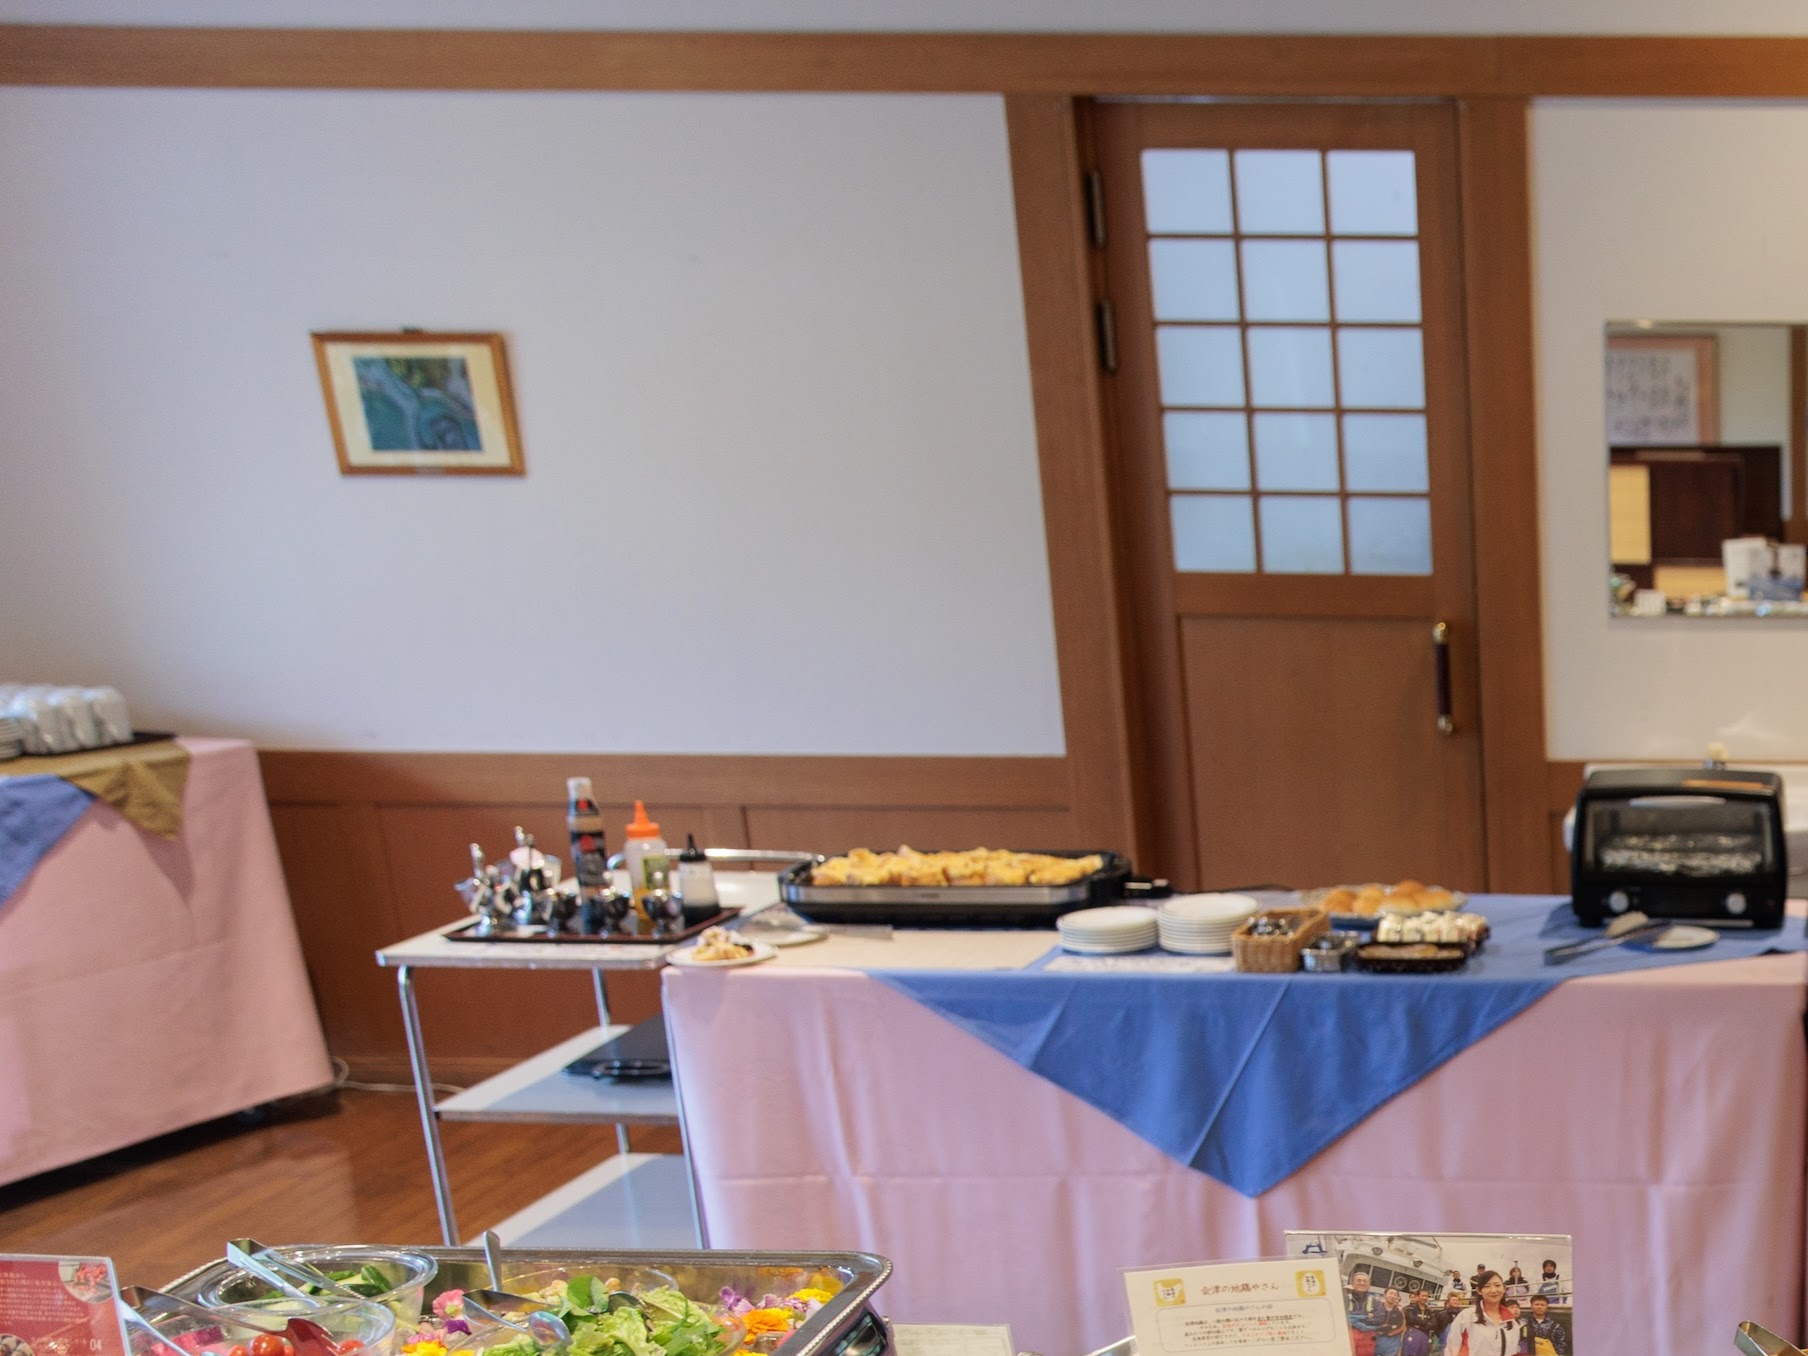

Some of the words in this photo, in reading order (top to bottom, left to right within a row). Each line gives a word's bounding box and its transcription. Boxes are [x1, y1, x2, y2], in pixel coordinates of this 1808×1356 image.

[1200, 1283, 1279, 1297] 会津の地鶏やさん
[89, 1338, 102, 1351] 04
